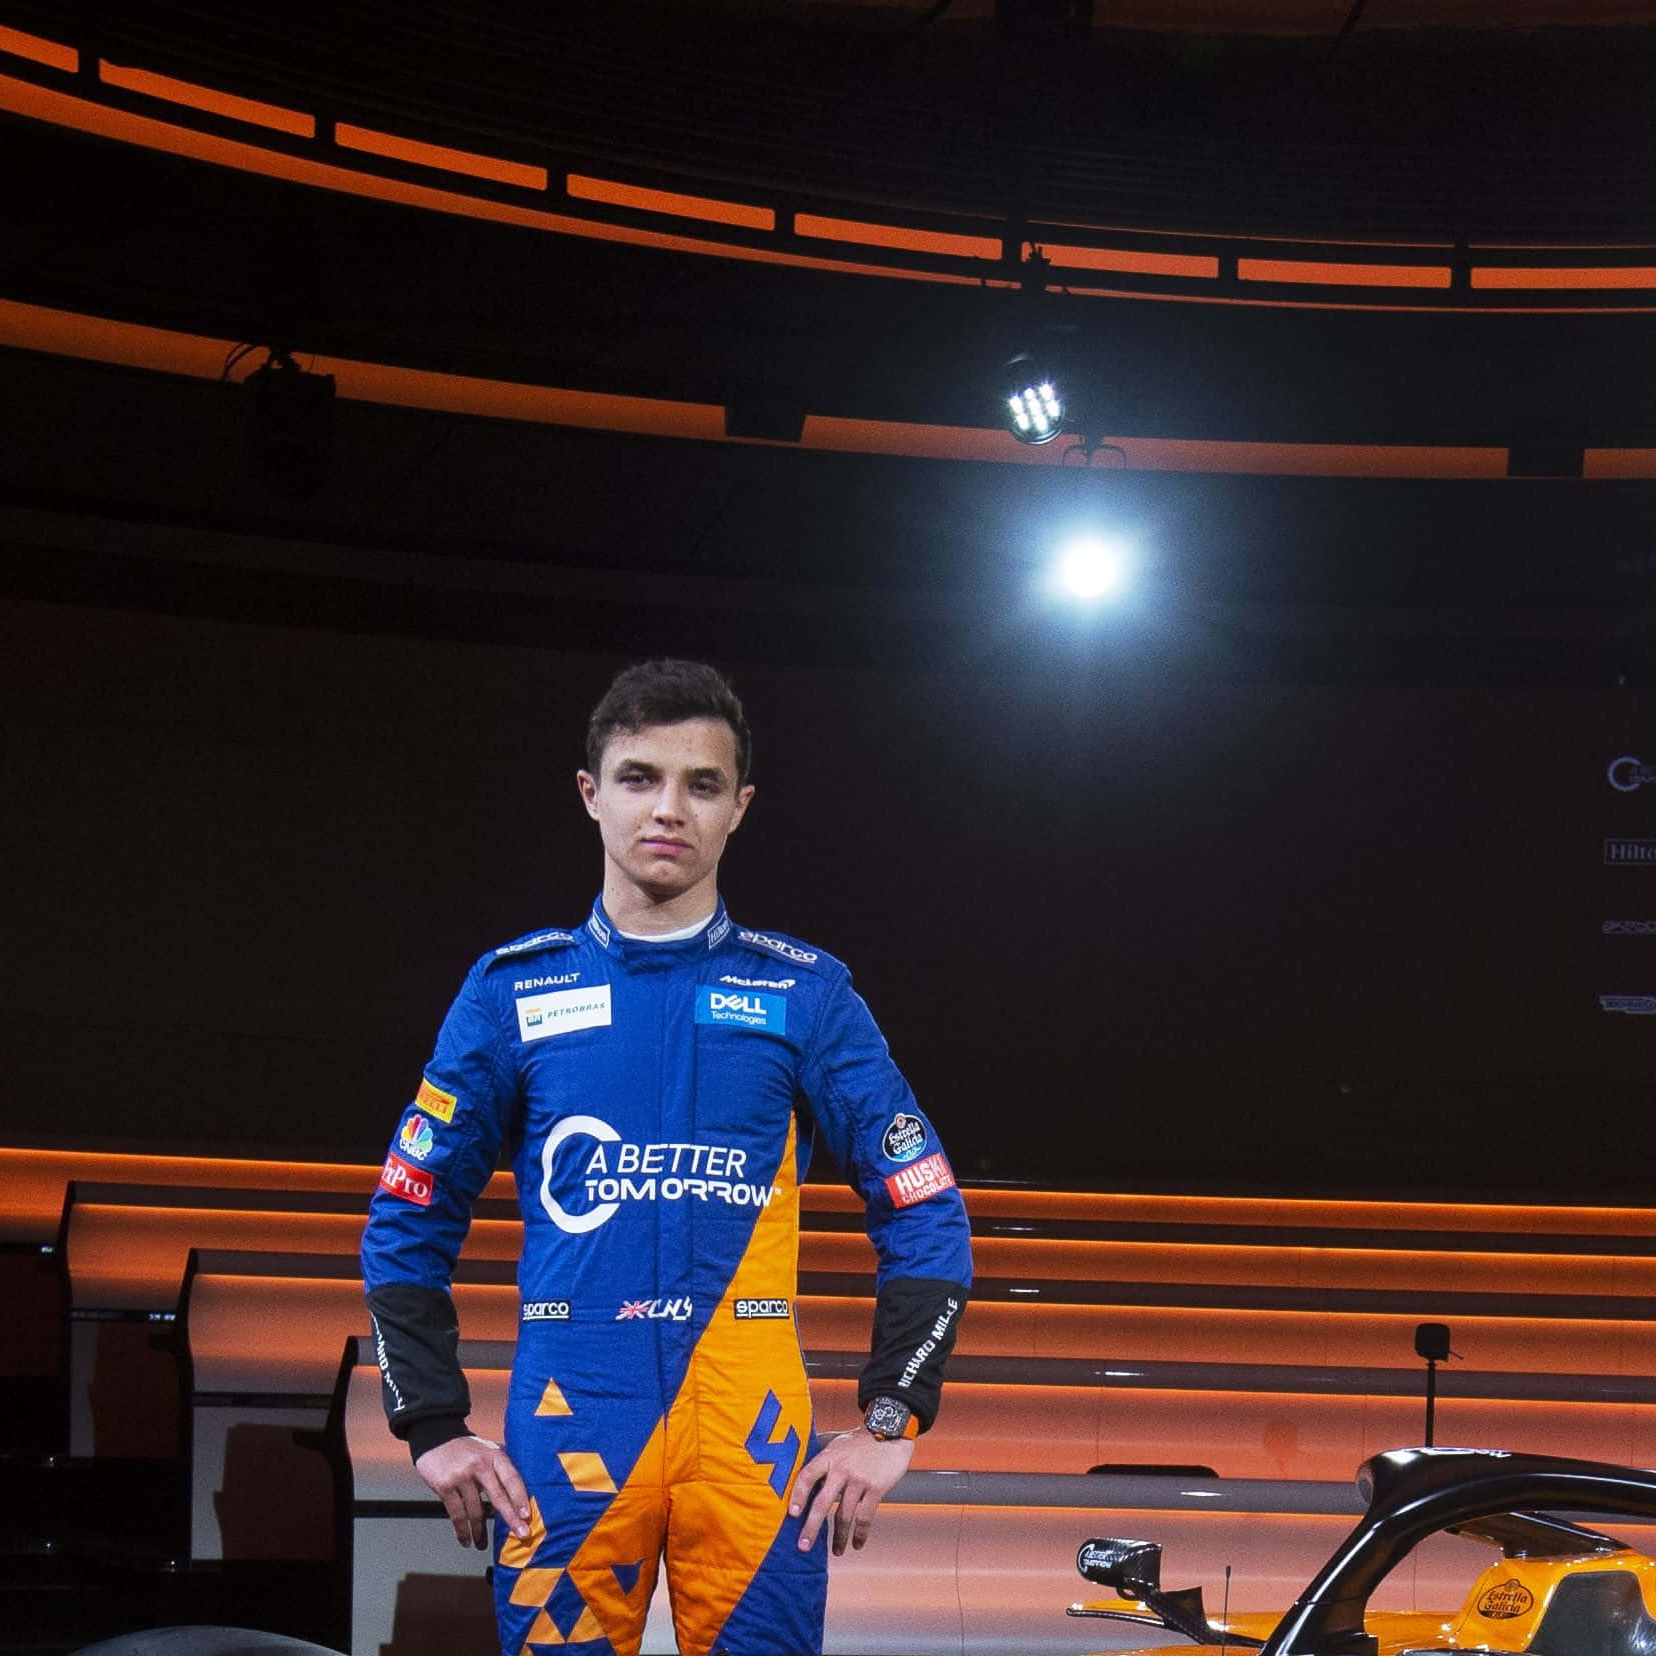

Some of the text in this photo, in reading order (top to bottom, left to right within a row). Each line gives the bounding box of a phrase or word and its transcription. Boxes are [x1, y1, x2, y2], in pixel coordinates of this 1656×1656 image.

[738, 930, 818, 964] sparco
[514, 973, 581, 991] RENAULT
[547, 1002, 606, 1018] PETROBRAS
[710, 992, 767, 1014] DELL
[585, 1143, 747, 1179] A BETTER
[585, 1178, 772, 1207] TOMORROW
[523, 1301, 570, 1320] sparco
[735, 1299, 789, 1317] sparco
